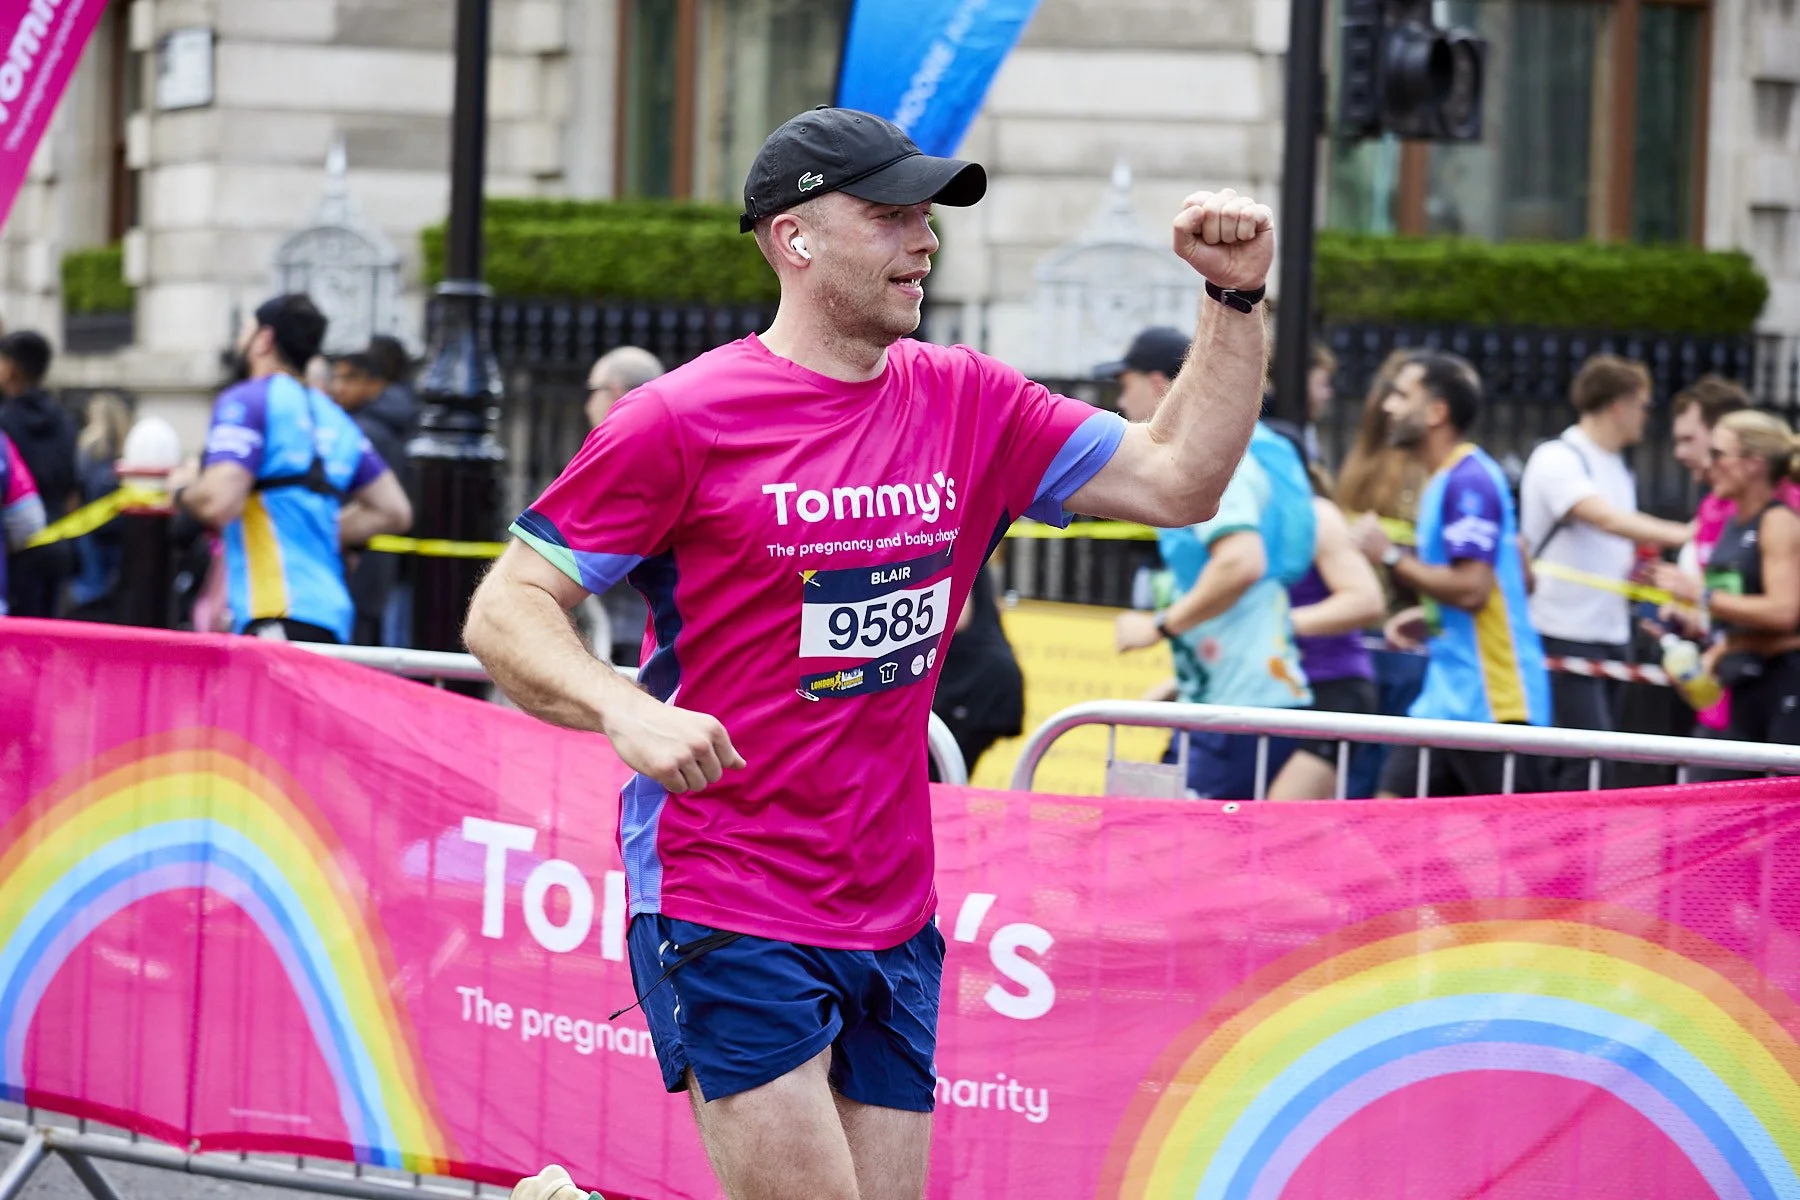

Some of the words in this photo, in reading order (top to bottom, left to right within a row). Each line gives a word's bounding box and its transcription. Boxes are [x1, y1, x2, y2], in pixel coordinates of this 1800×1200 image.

[762, 471, 956, 525] Tommy's
[767, 544, 795, 557] The
[800, 536, 874, 557] pregnancy
[876, 533, 902, 549] and
[905, 530, 934, 547] baby
[871, 566, 911, 585] BLAIR
[828, 590, 934, 651] 9585
[455, 985, 514, 1030] The
[521, 1007, 658, 1060] pregnan
